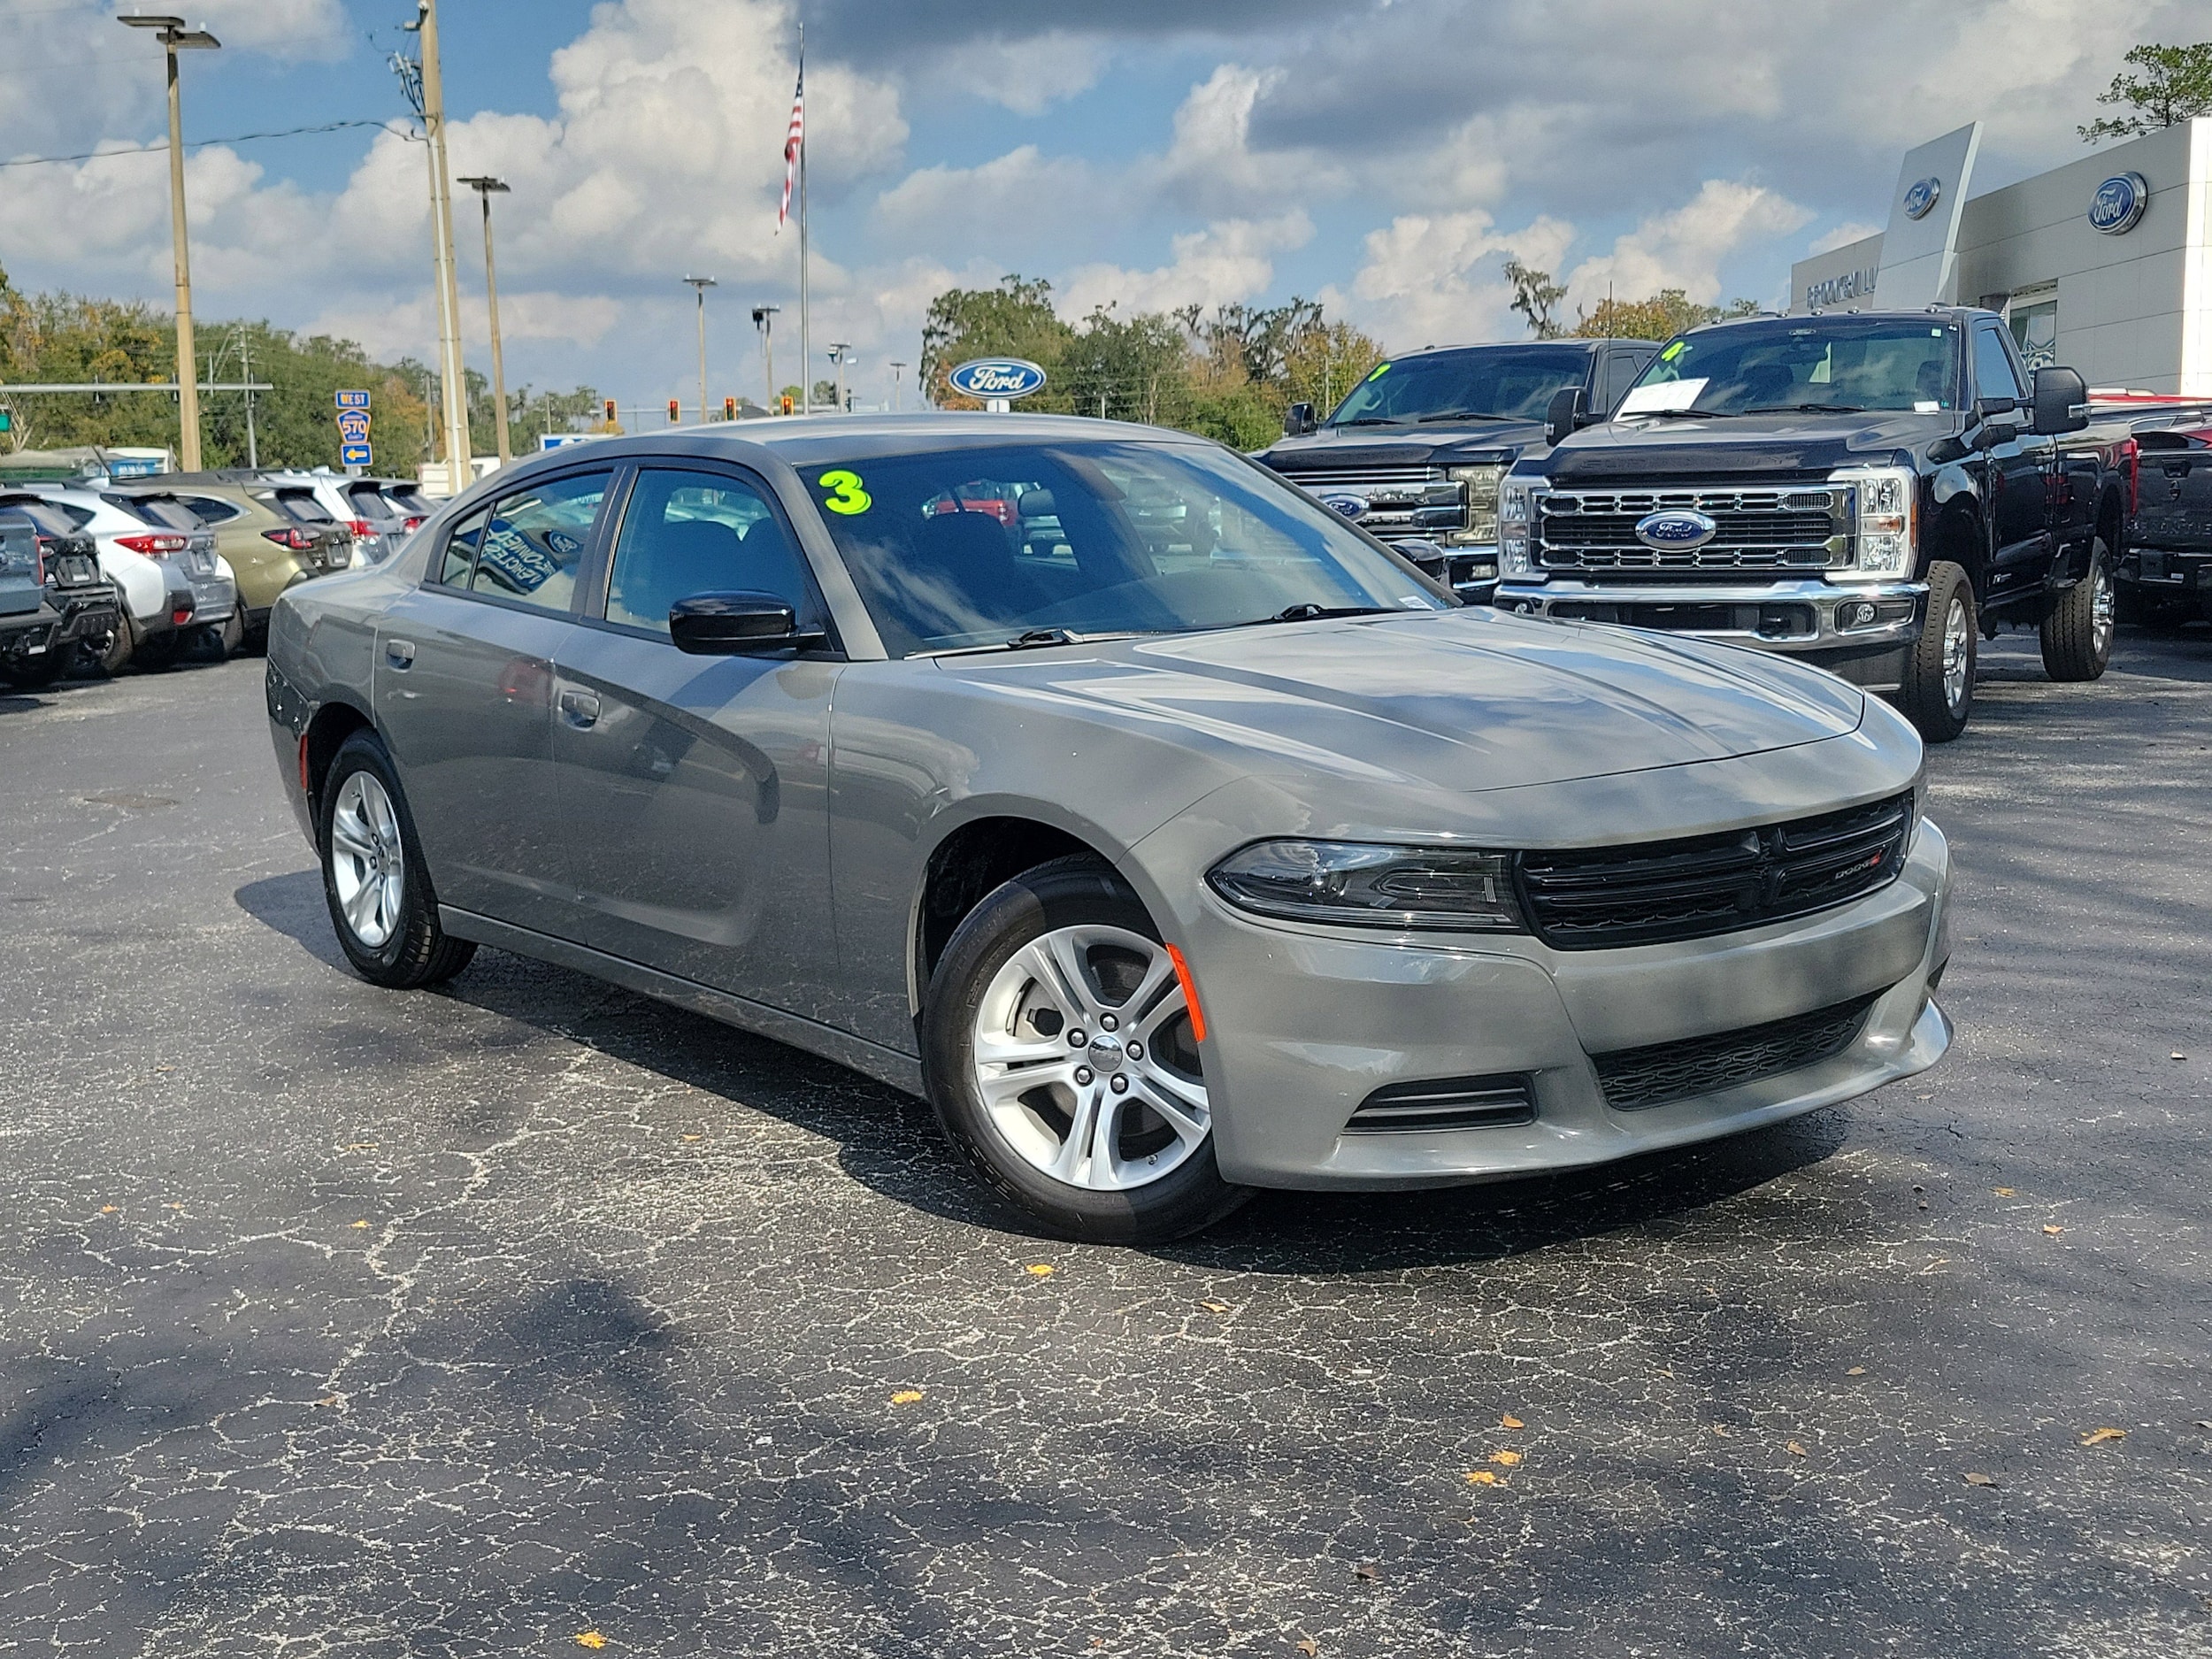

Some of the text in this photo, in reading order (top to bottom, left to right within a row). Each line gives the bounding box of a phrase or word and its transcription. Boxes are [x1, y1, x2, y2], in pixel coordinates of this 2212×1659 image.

[1906, 186, 1927, 211] Ford
[2093, 188, 2124, 224] Ford
[969, 366, 1026, 390] Ford
[340, 394, 365, 404] WEST
[342, 419, 367, 434] 570
[818, 470, 872, 515] 3
[1655, 521, 1694, 538] Ford
